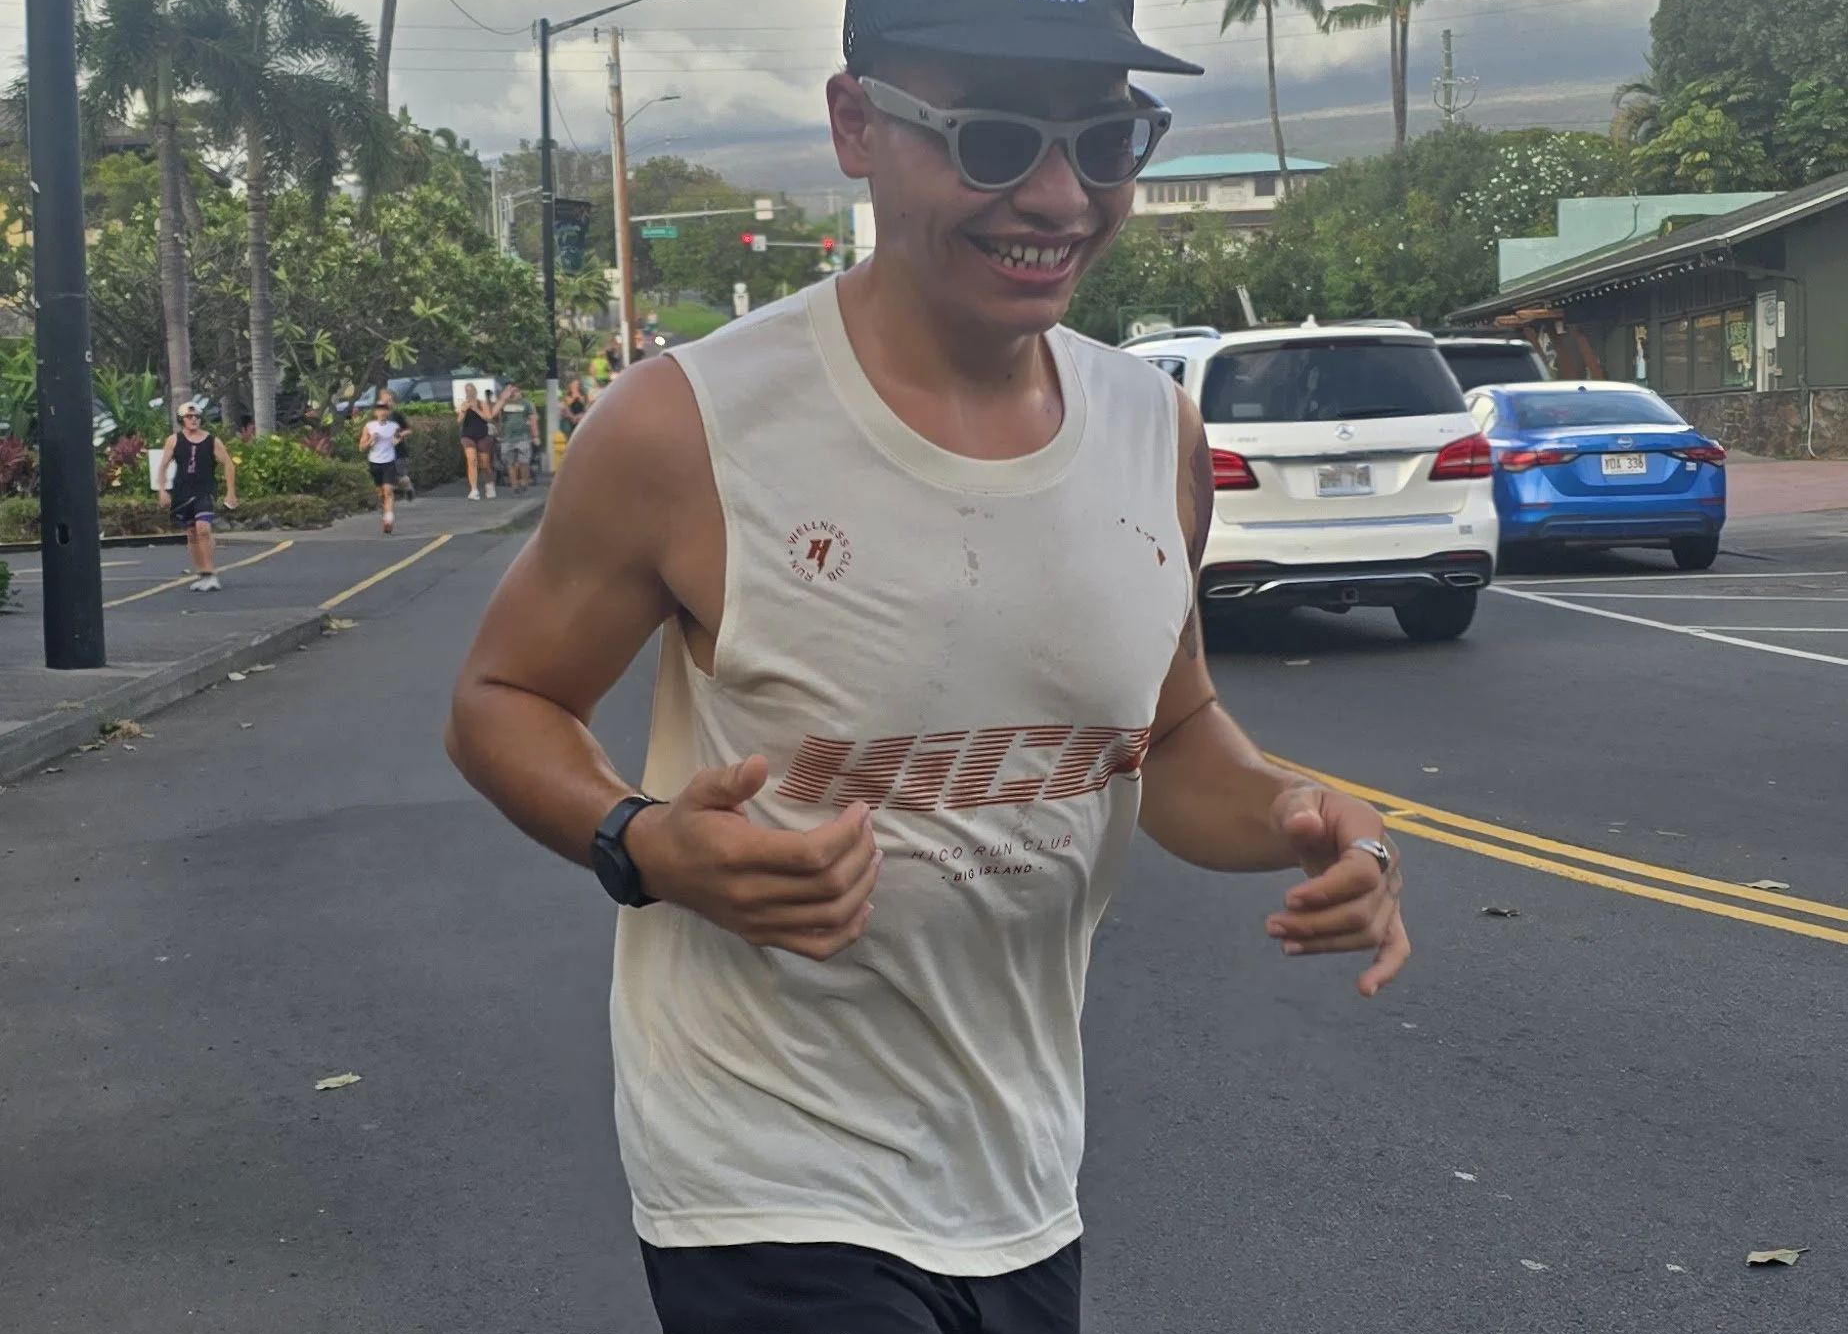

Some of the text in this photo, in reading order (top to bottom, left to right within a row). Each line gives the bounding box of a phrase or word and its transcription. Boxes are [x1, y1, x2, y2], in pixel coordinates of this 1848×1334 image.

[787, 520, 852, 583] RUN WELLNESS CLUB
[911, 833, 1073, 864] HICO RUN CLUB
[953, 864, 1034, 883] BIG ISLAND
